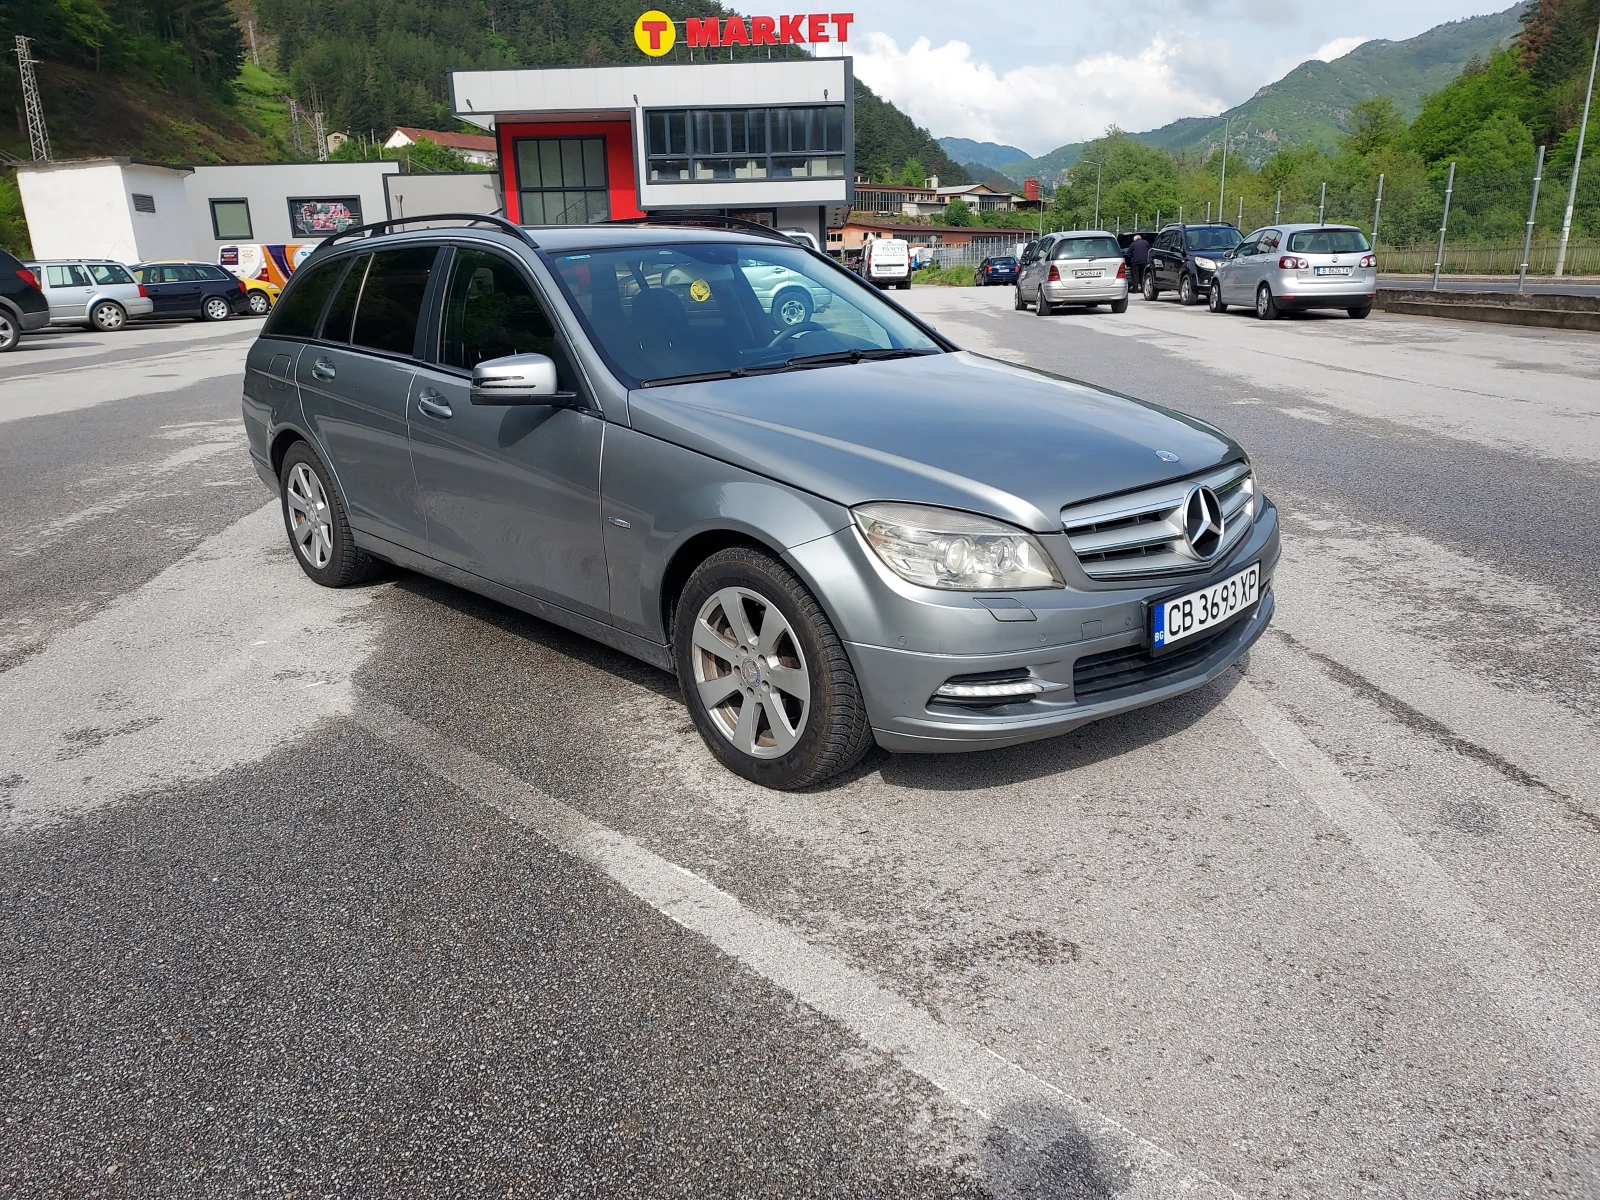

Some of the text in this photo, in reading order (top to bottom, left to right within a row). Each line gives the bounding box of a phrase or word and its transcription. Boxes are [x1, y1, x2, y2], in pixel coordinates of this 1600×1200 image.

[642, 13, 854, 49] T MARKET
[1168, 569, 1257, 637] CB 3693 XP
[1154, 630, 1164, 642] BG
